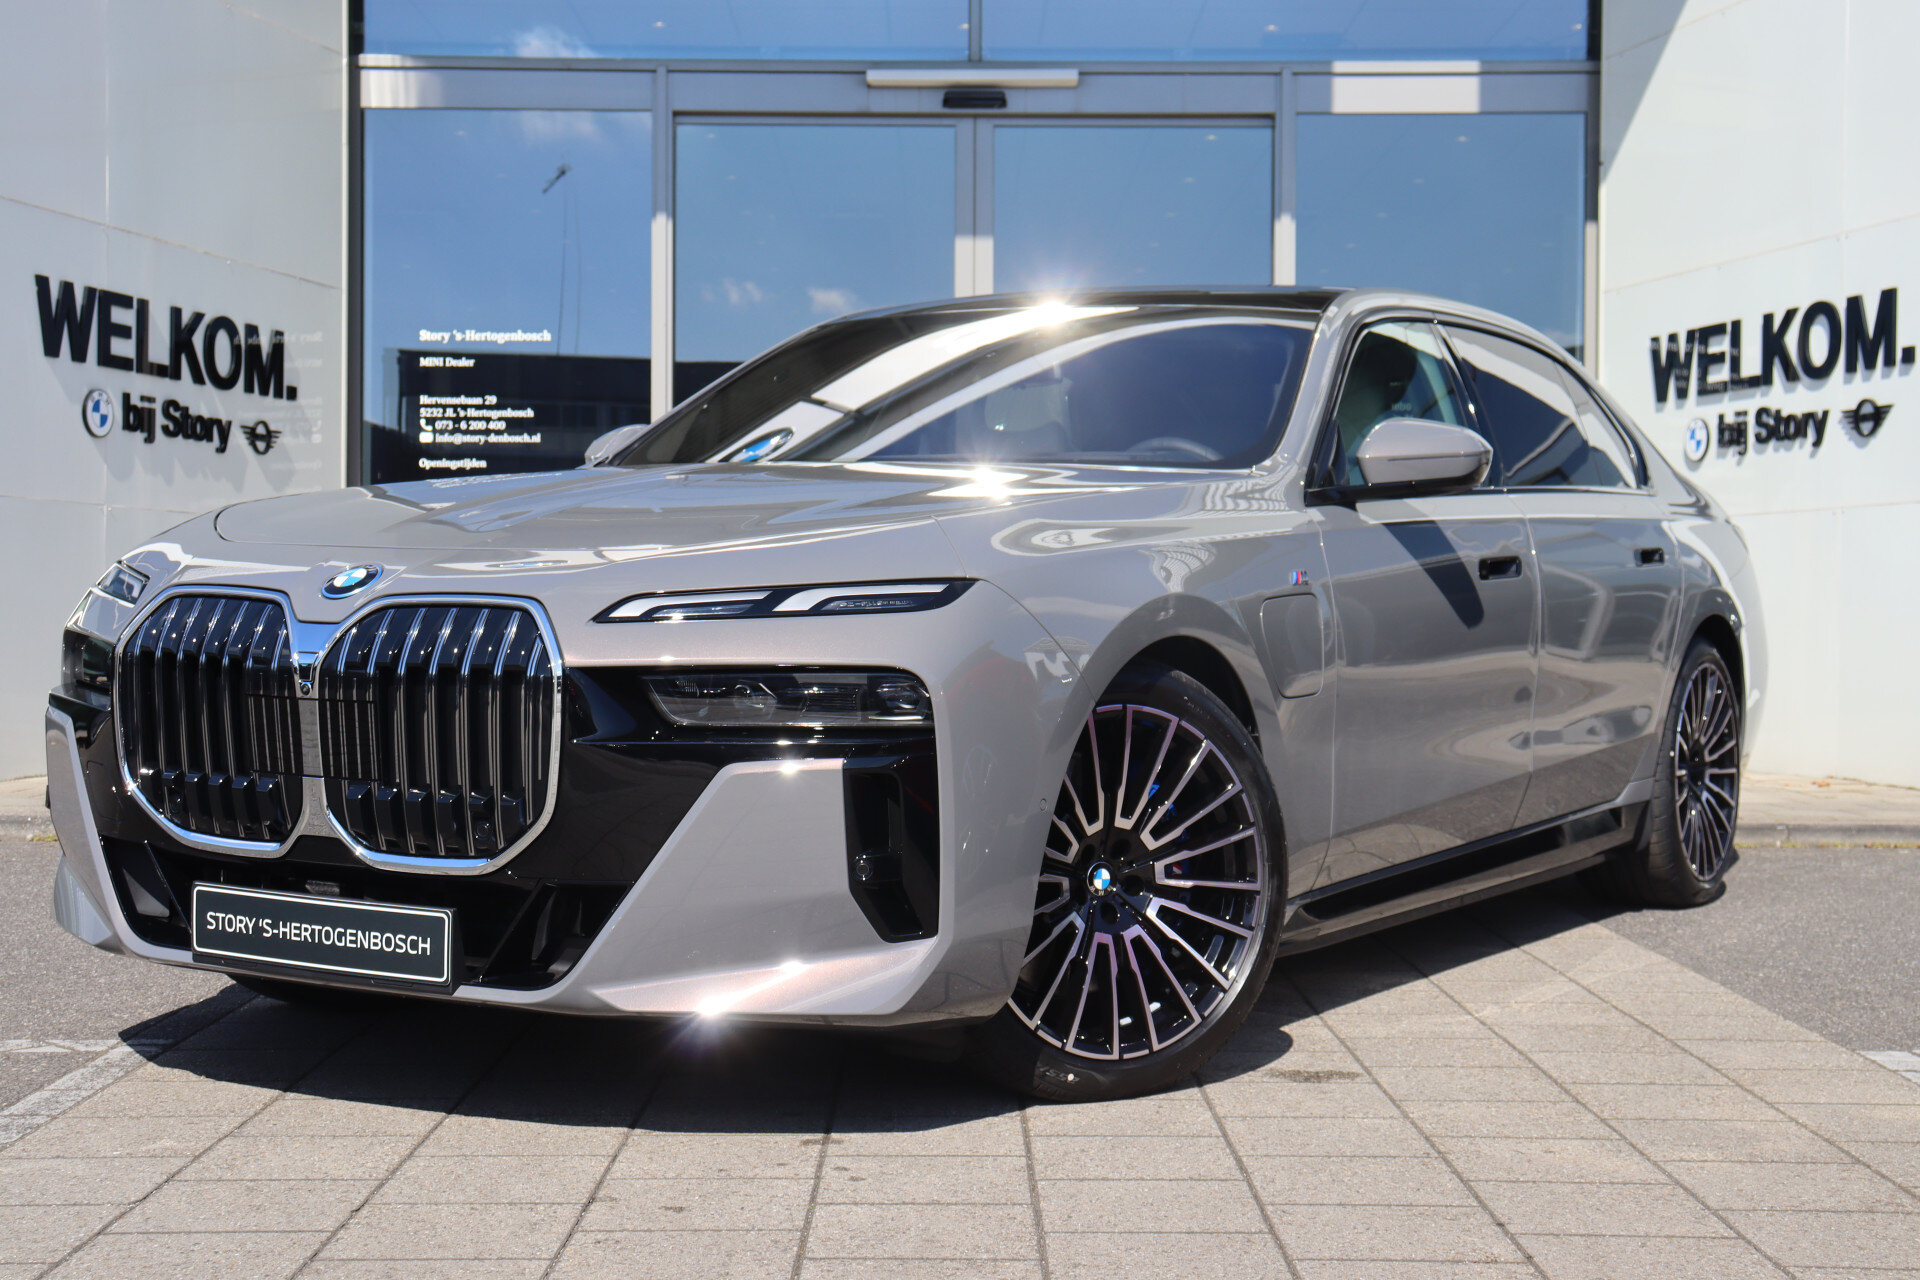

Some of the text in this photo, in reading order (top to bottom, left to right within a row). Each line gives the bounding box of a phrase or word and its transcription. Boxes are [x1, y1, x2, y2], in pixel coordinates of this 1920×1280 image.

[35, 274, 298, 400] WELKOM.
[419, 329, 552, 344] Story 's-Hertogenbosch
[1649, 286, 1916, 404] WELKOM.
[419, 357, 476, 367] MINI Dealer
[484, 395, 498, 405] 29
[419, 407, 443, 418] 5232
[444, 408, 457, 418] JL
[122, 391, 233, 454] bij Story
[434, 420, 454, 431] 073
[460, 420, 467, 431] 6
[468, 420, 487, 431] 200
[487, 420, 507, 431] 400
[1717, 406, 1829, 456] bij Story
[418, 457, 487, 471] Openingstijden
[206, 911, 432, 956] STORY 'S-HERTOGENBOSCH
